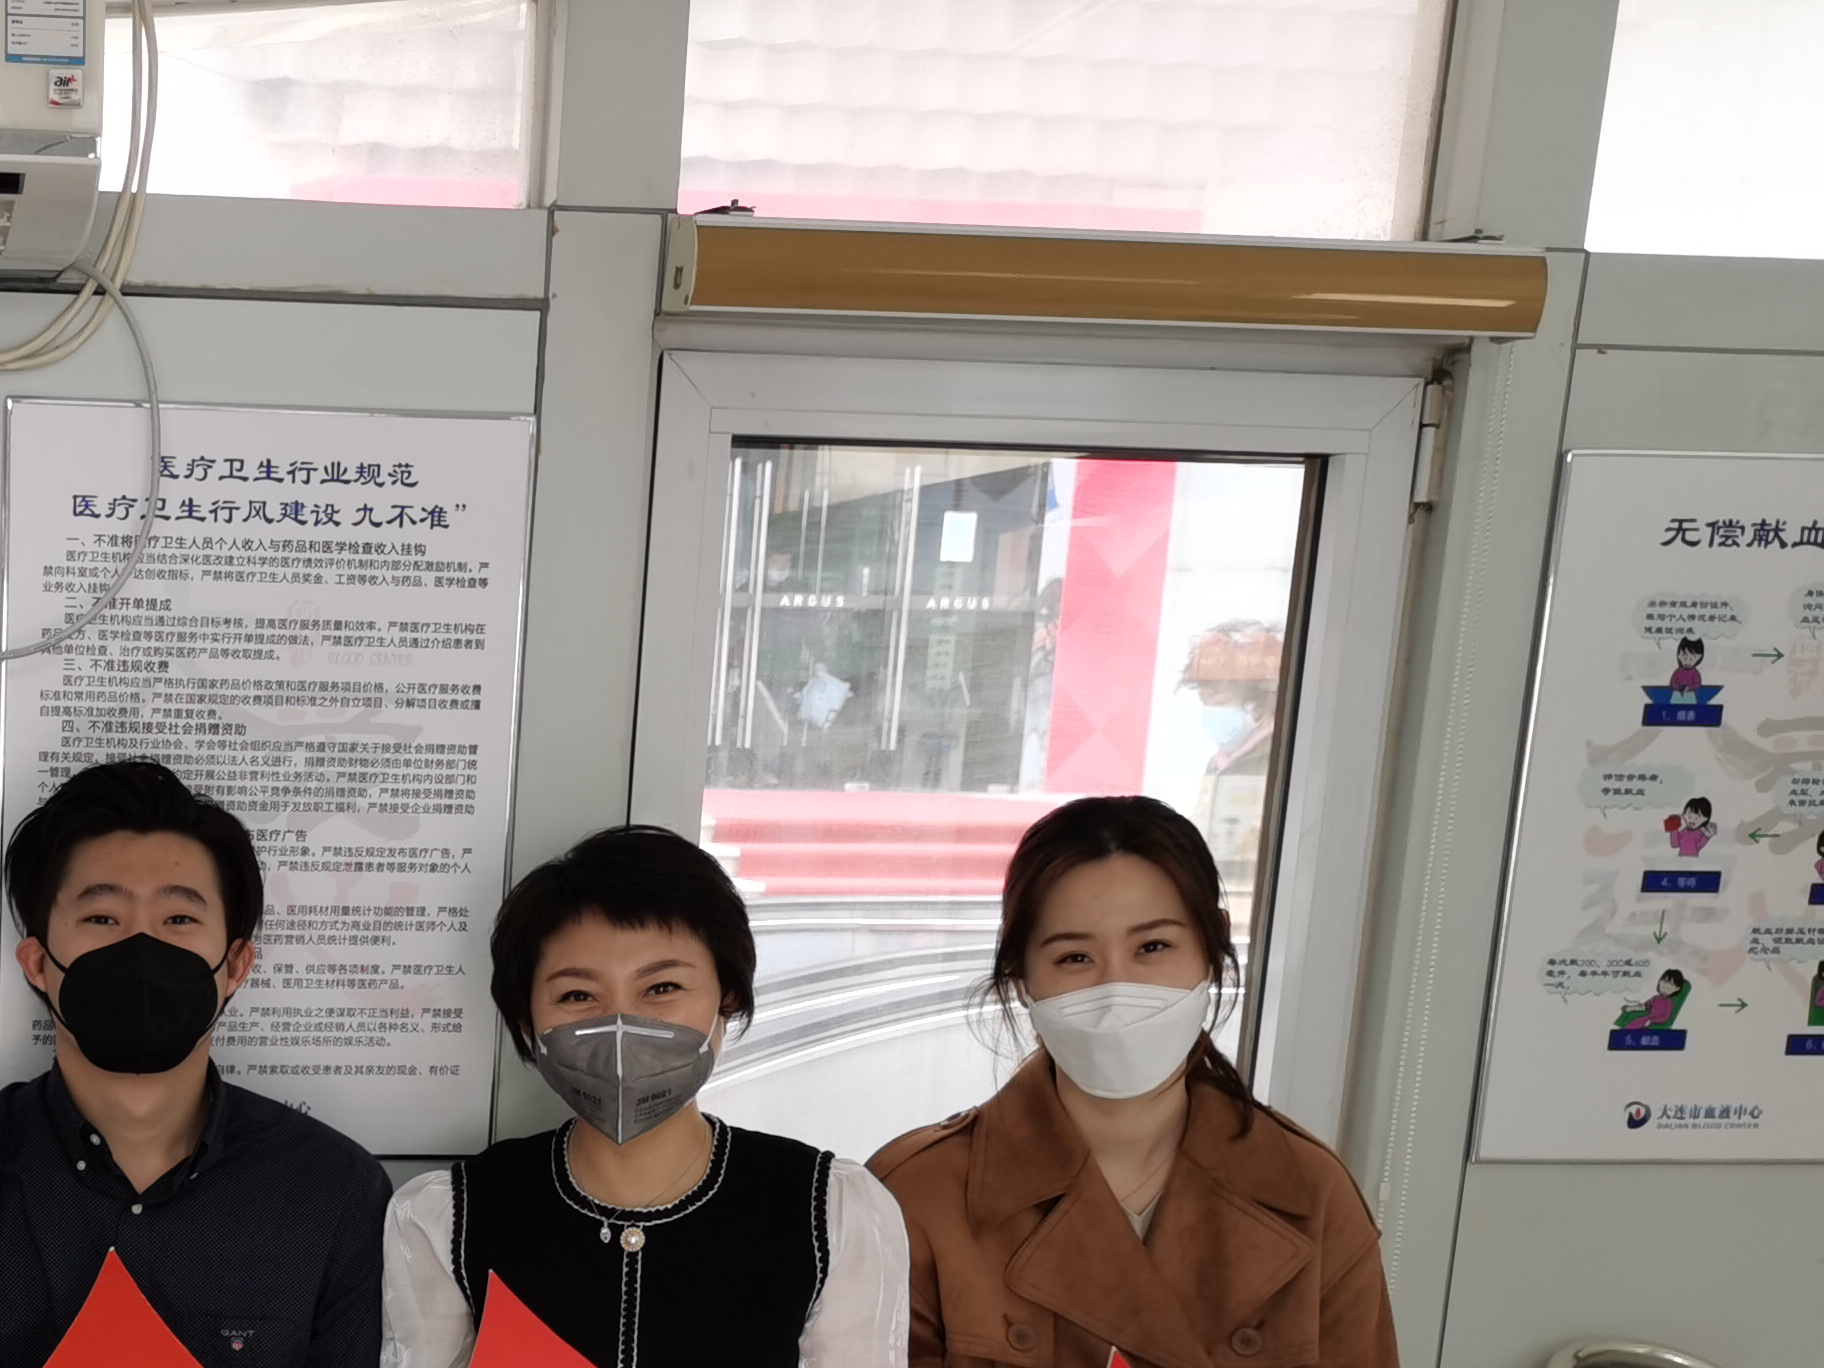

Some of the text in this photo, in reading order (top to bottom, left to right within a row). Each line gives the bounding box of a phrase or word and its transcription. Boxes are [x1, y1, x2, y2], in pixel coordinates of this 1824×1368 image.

[1659, 517, 1824, 550] 无偿献血
[219, 1328, 256, 1338] GANT
